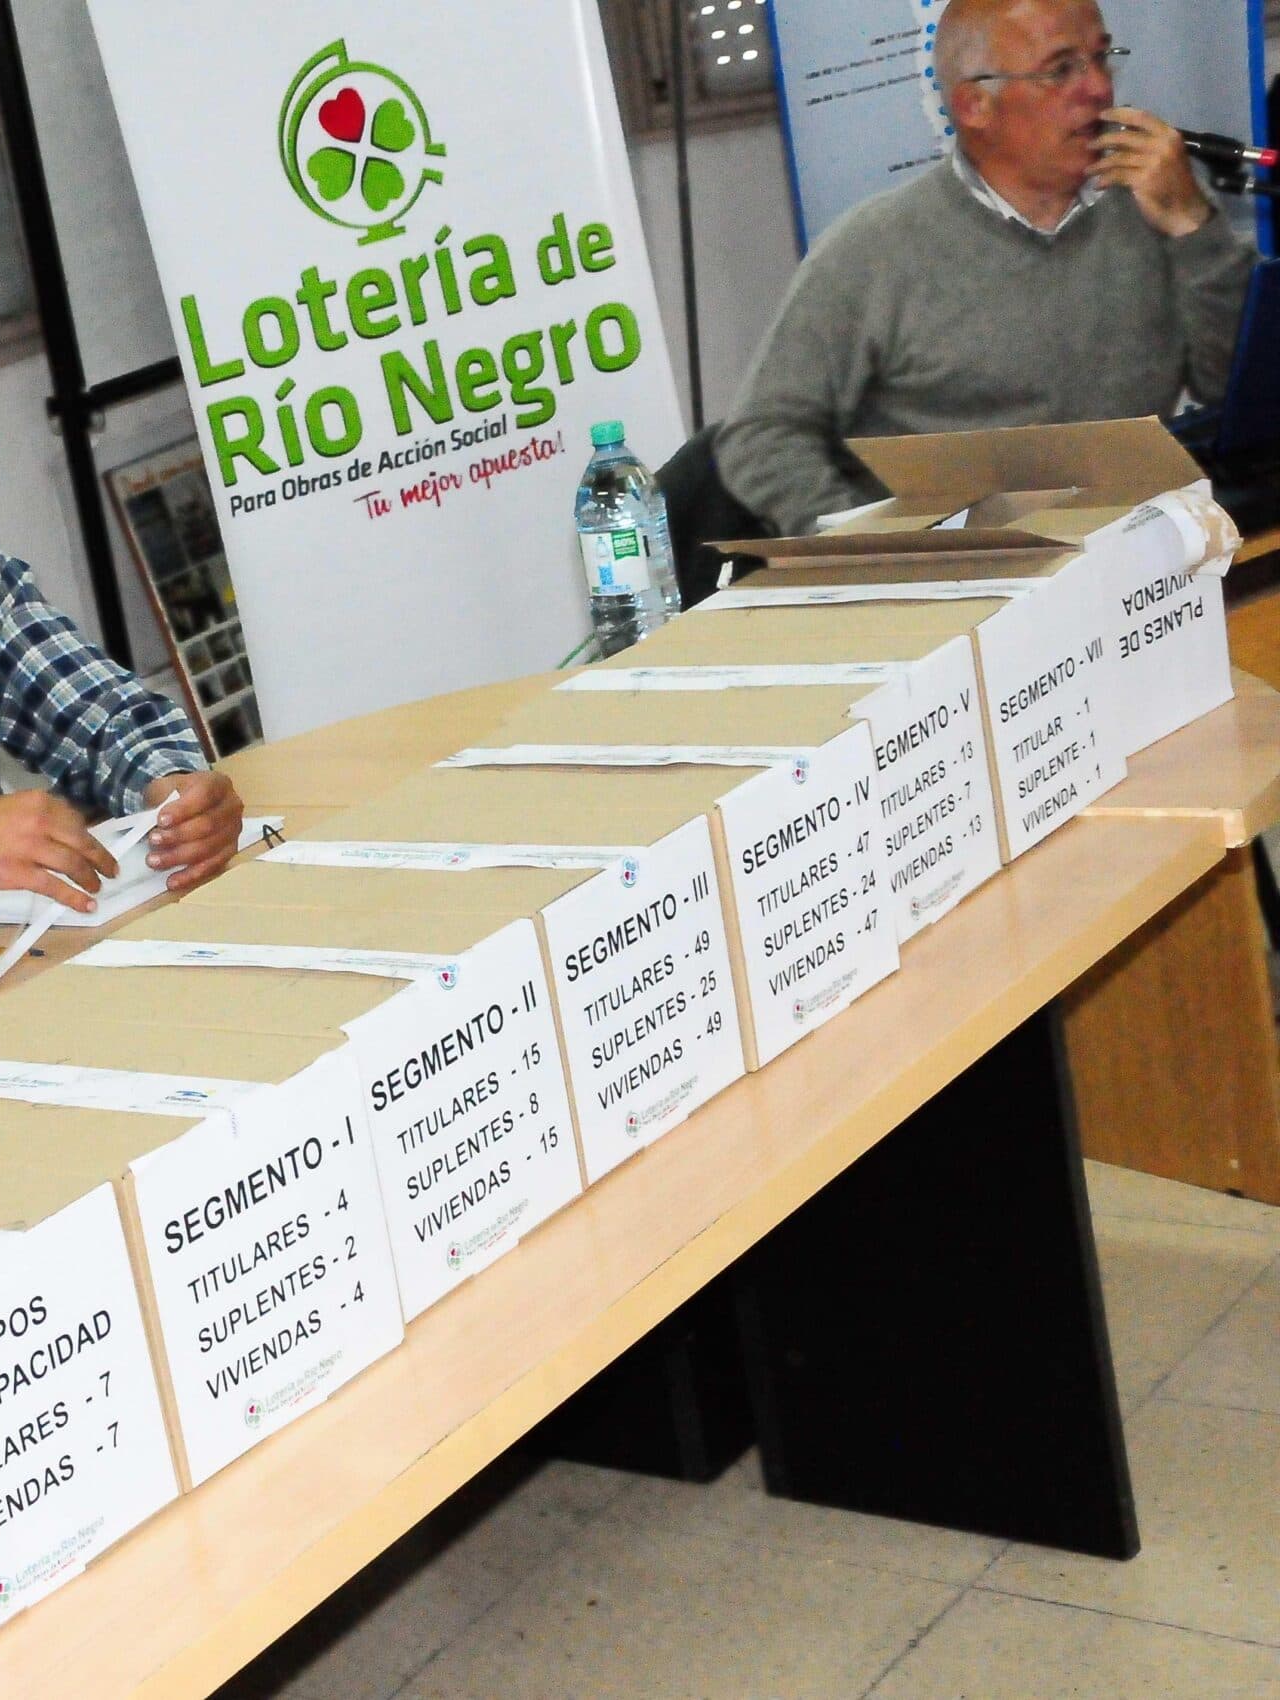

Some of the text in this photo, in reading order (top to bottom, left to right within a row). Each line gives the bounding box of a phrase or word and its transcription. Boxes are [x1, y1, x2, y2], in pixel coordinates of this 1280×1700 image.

[180, 212, 616, 387] Lotería de
[206, 302, 642, 487] Río Negro
[231, 414, 508, 517] Para Obras de Acción Social
[354, 431, 567, 520] Tu mejor apuesta!
[1119, 596, 1204, 659] PLANES DE
[999, 656, 1076, 724] SEGMENTO
[874, 704, 949, 772] EGMENTO
[1012, 715, 1064, 763] TITULAR
[1018, 741, 1080, 799] SUPLENTE
[880, 759, 946, 819] TITULARES
[885, 793, 956, 857] SUPLENTES
[1022, 782, 1078, 833] VIVIENDA
[742, 796, 841, 875] SEGMENTO
[890, 834, 954, 894] VIVIENDAS
[756, 852, 839, 917] TITULARES
[763, 887, 849, 958] SUPLENTES
[565, 893, 677, 983] SEGMENTO
[768, 931, 845, 997] VIVIENDAS
[583, 953, 674, 1027] TITULARES
[371, 1003, 504, 1112] SEGMENTO
[591, 991, 687, 1070] SUPLENTES
[396, 1071, 500, 1155] TITULARES
[597, 1038, 683, 1110] VIVIENDAS
[406, 1110, 514, 1200] SUPLENTES
[164, 1136, 323, 1255] SEGMENTO
[413, 1160, 511, 1243] VIVIENDAS
[187, 1213, 310, 1304] TITULARES
[198, 1254, 327, 1353] SUPLENTES
[205, 1309, 322, 1400] VIVIENDAS
